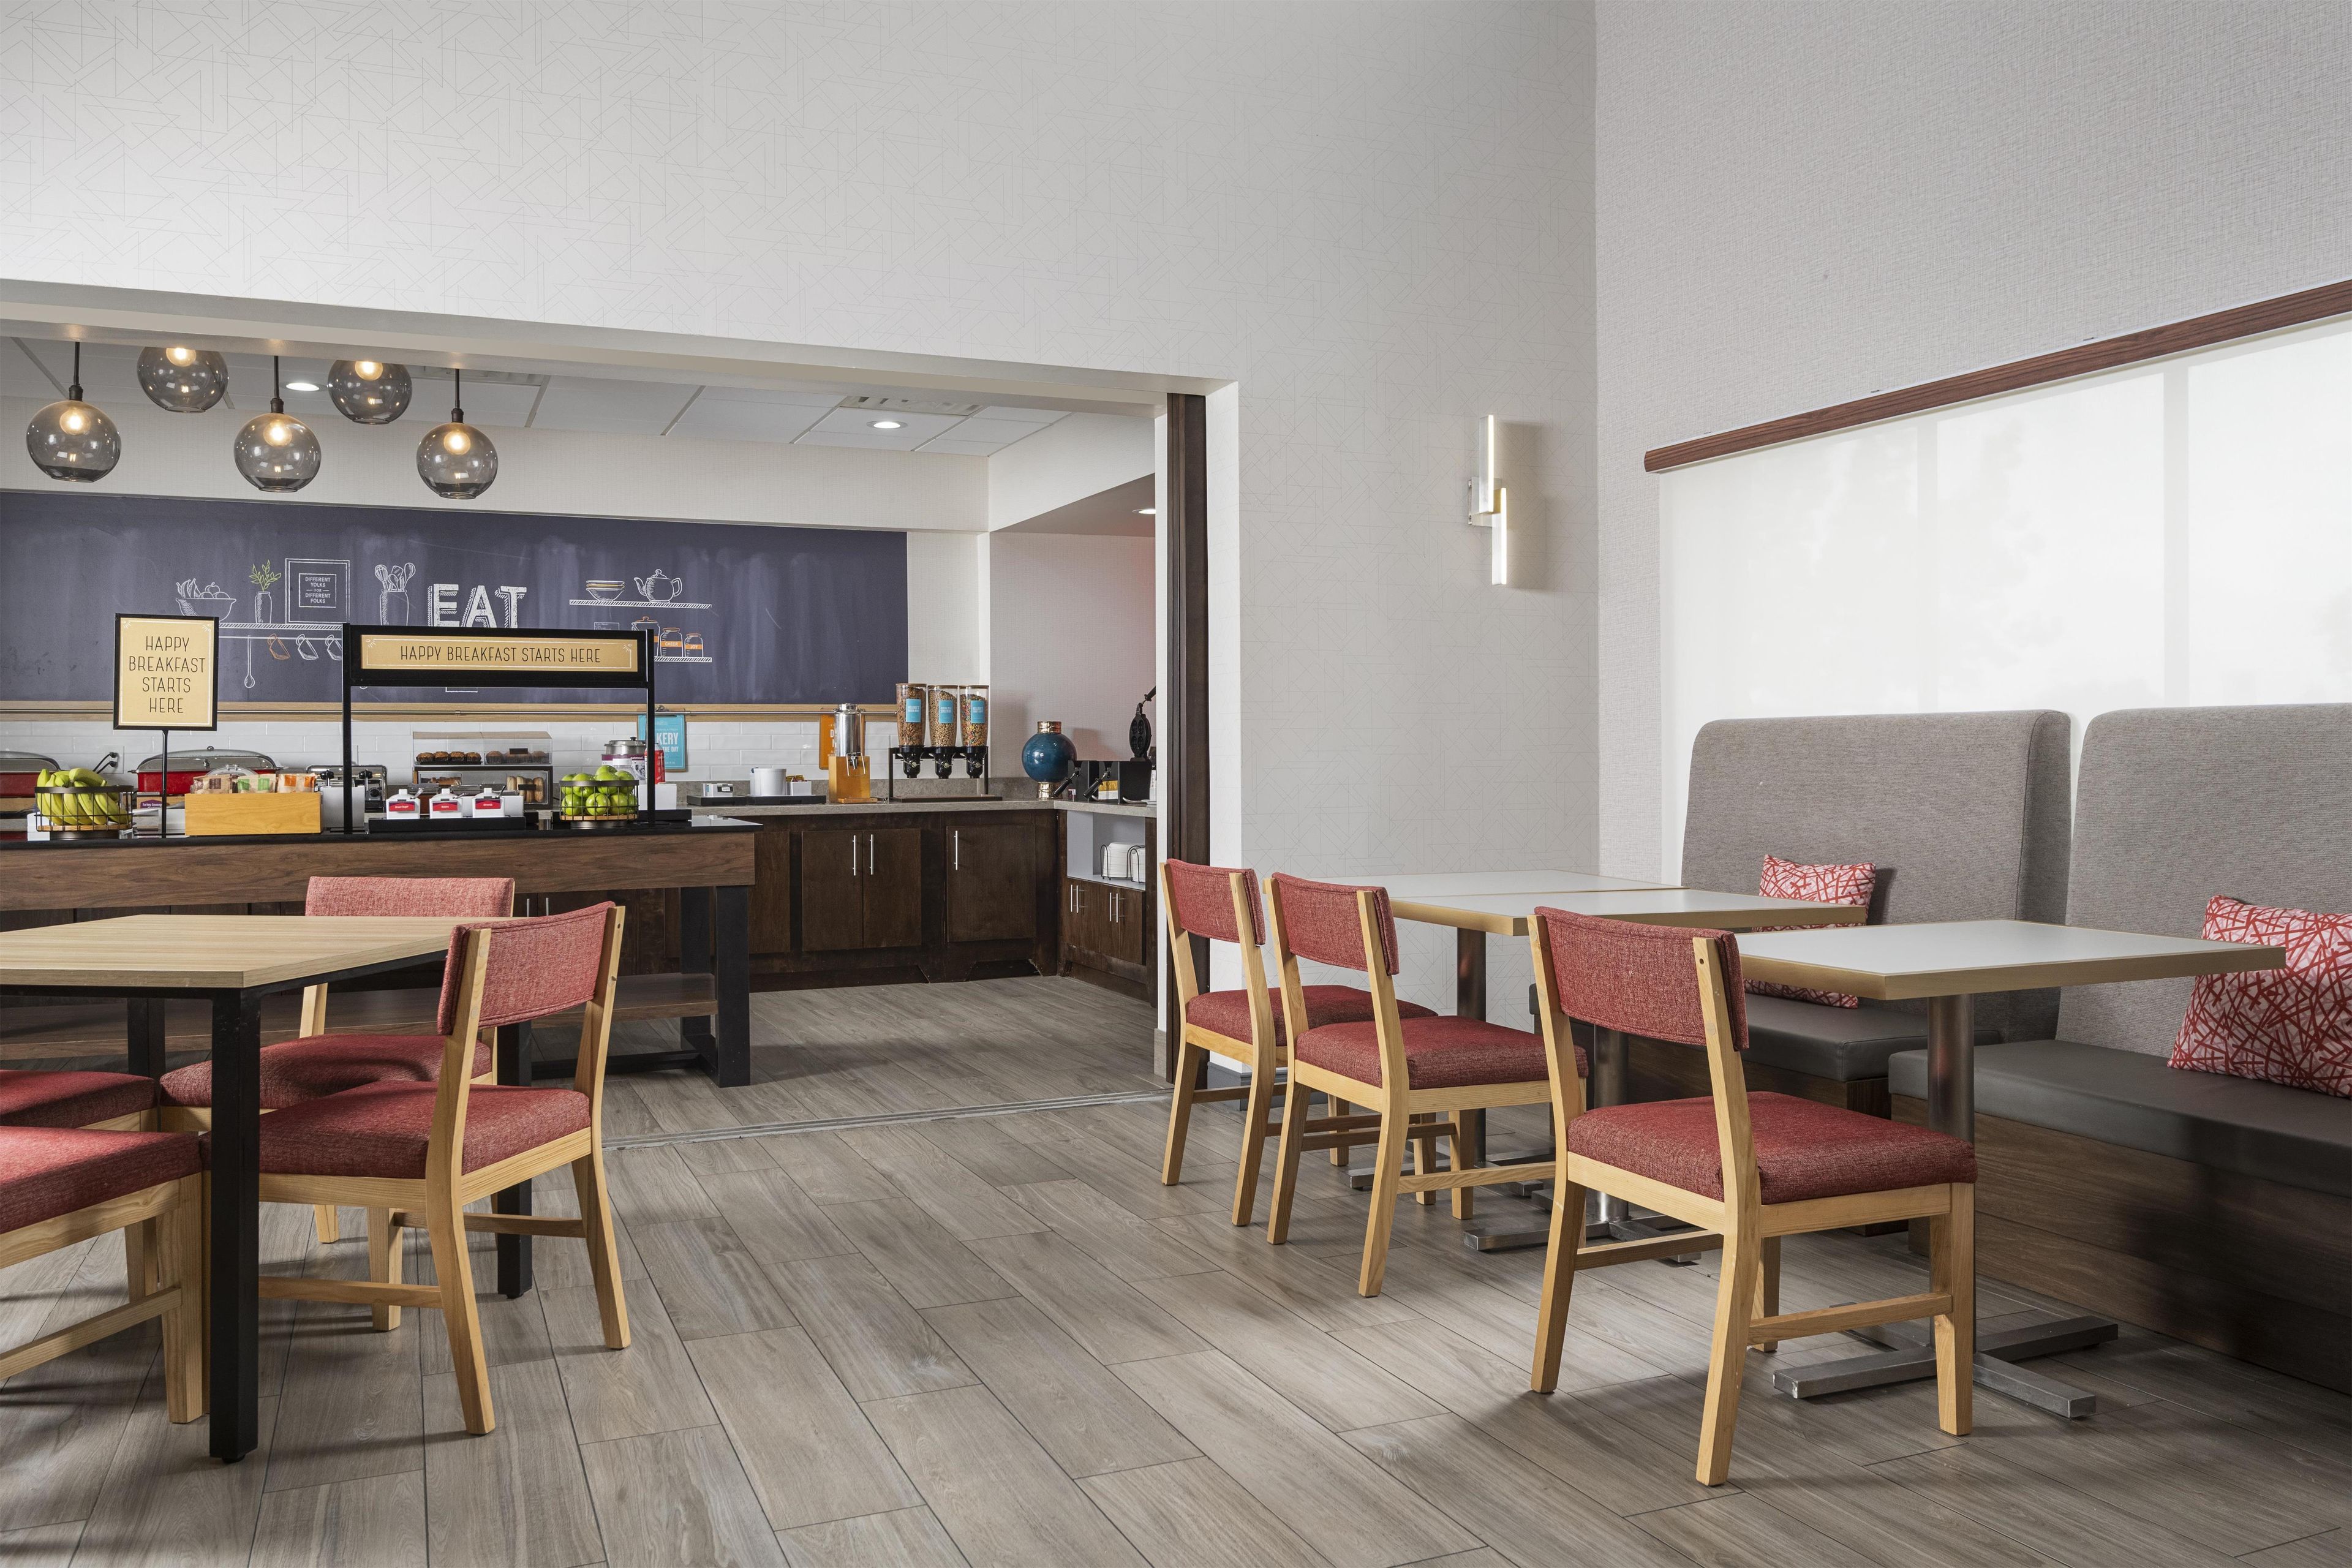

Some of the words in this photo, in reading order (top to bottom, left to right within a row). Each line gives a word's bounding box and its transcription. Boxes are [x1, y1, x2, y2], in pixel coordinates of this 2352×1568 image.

[428, 583, 527, 628] EAT
[146, 636, 190, 652] HAPPY
[400, 645, 442, 660] HAPPY
[447, 647, 517, 662] BREAKFAST
[521, 647, 565, 662] STARTS
[571, 648, 601, 663] HERE
[129, 655, 206, 673] BREAKFAST
[142, 677, 191, 693] STARTS
[149, 698, 184, 713] HERE
[656, 733, 679, 745] KERY
